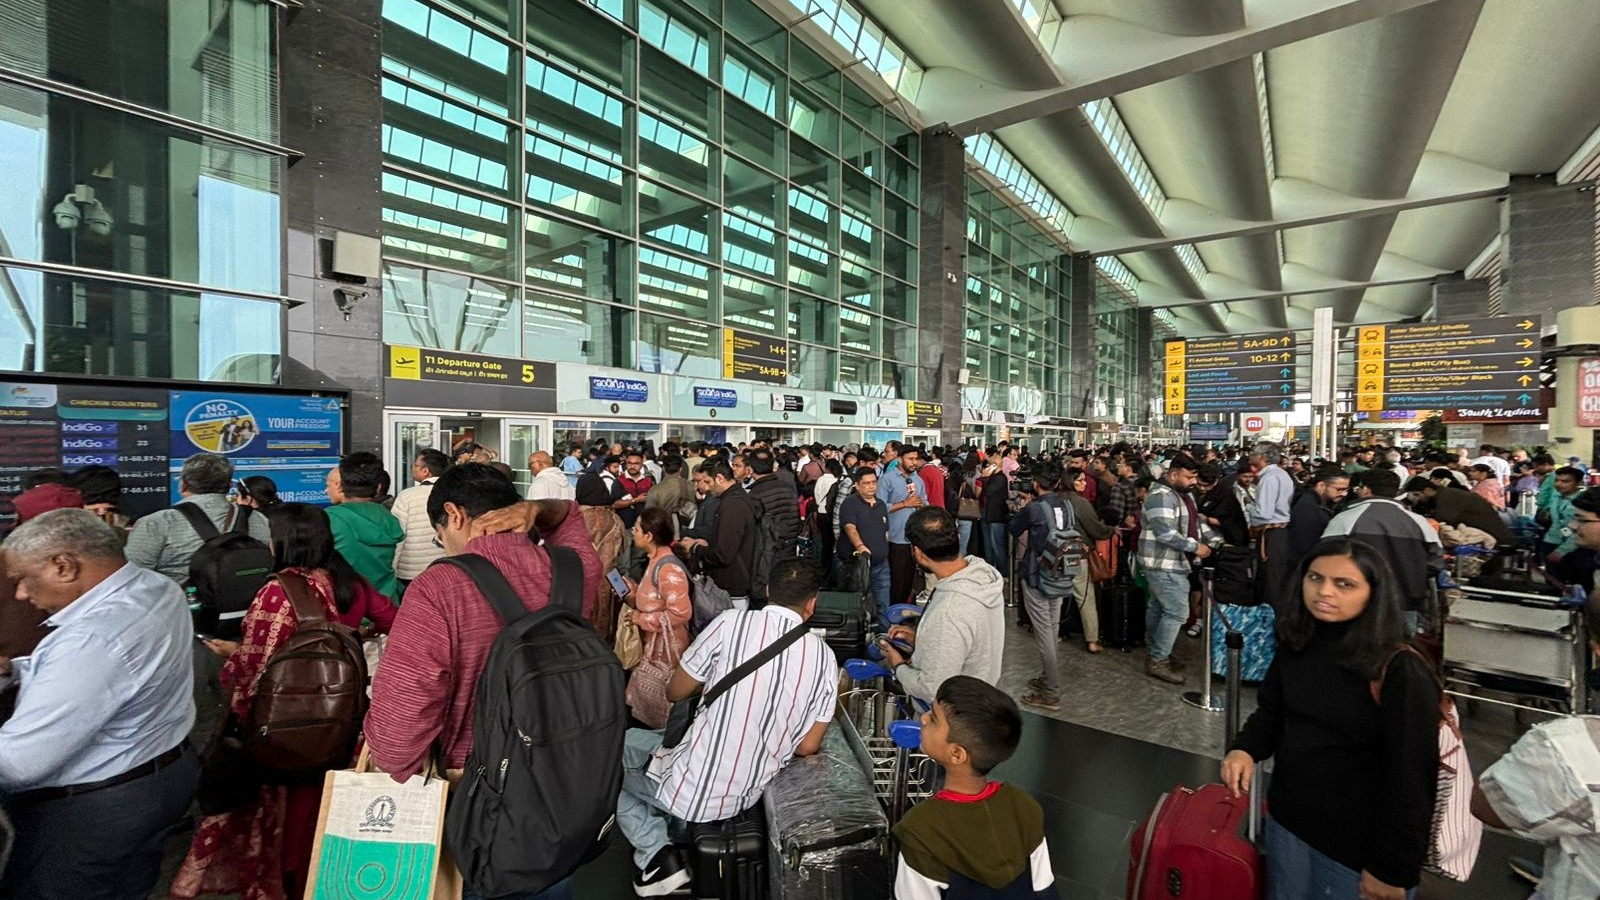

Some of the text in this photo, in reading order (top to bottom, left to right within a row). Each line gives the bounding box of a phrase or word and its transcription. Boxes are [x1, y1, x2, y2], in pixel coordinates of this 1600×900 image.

[1243, 338, 1278, 348] 5A-9D
[769, 345, 779, 354] 1-4
[1250, 354, 1278, 363] 10-12
[425, 355, 535, 383] T1 Departure Gate 5
[1389, 376, 1416, 384] Airport
[626, 382, 647, 391] IndiGo
[205, 402, 228, 413] NO
[934, 405, 942, 415] 5A
[199, 409, 239, 419] PENALTY
[1457, 408, 1541, 418] South Indian
[62, 422, 102, 432] IndiGo
[268, 417, 294, 429] YOUR
[62, 438, 103, 448] IndiGo
[62, 454, 103, 465] IndiGo
